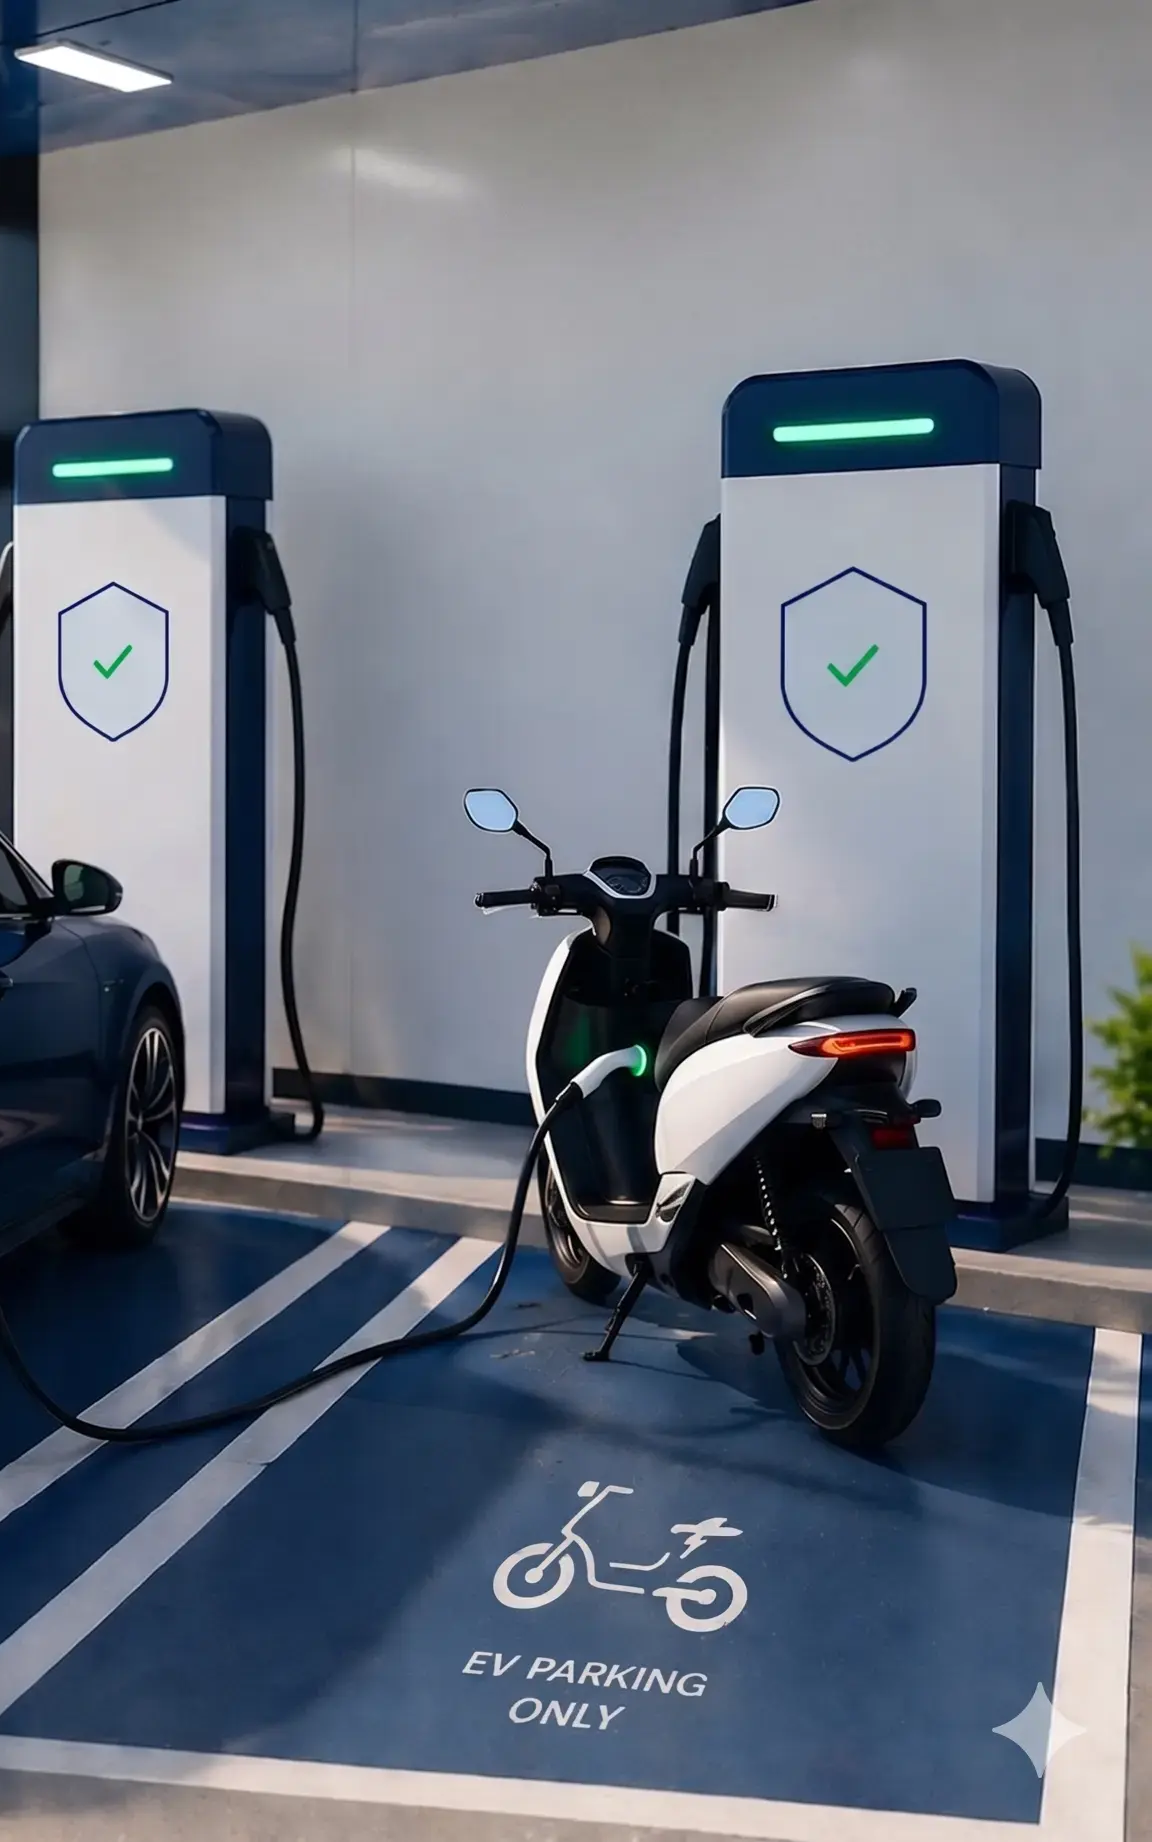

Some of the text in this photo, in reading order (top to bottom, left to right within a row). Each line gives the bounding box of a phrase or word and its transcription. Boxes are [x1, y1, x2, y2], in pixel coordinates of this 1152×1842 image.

[462, 1652, 707, 1696] EV PARKING
[509, 1698, 625, 1729] ONLY
